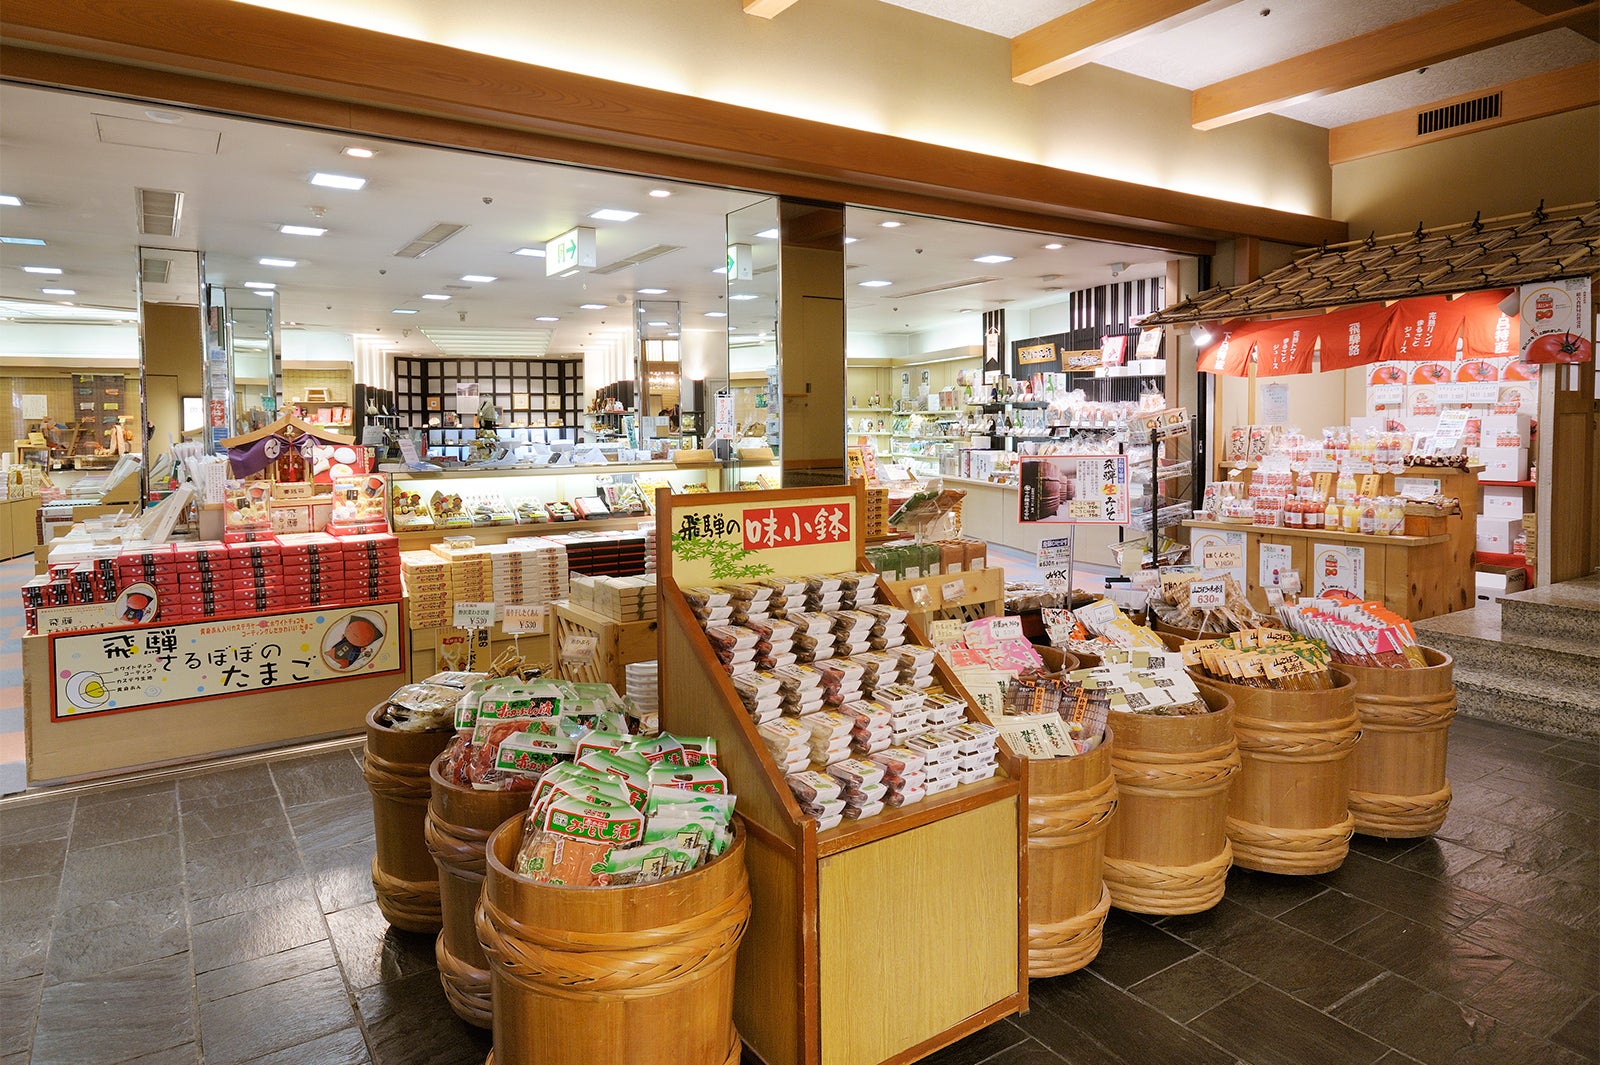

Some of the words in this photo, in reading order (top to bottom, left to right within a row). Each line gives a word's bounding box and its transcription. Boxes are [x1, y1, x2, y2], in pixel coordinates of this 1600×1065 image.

[1348, 322, 1360, 356] 飛騨路
[1400, 326, 1413, 353] ジュース
[1412, 319, 1424, 347] まるごと
[1424, 312, 1437, 347] 完熟リンゴ
[1494, 312, 1510, 354] 呂特産
[1272, 344, 1280, 369] ジュース
[1280, 338, 1290, 362] まるごと
[678, 513, 740, 541] 飛騨の
[745, 508, 848, 547] 味小鉢
[102, 628, 178, 659] 飛騨
[158, 641, 282, 672] さるぼぼの
[222, 655, 317, 688] たまご
